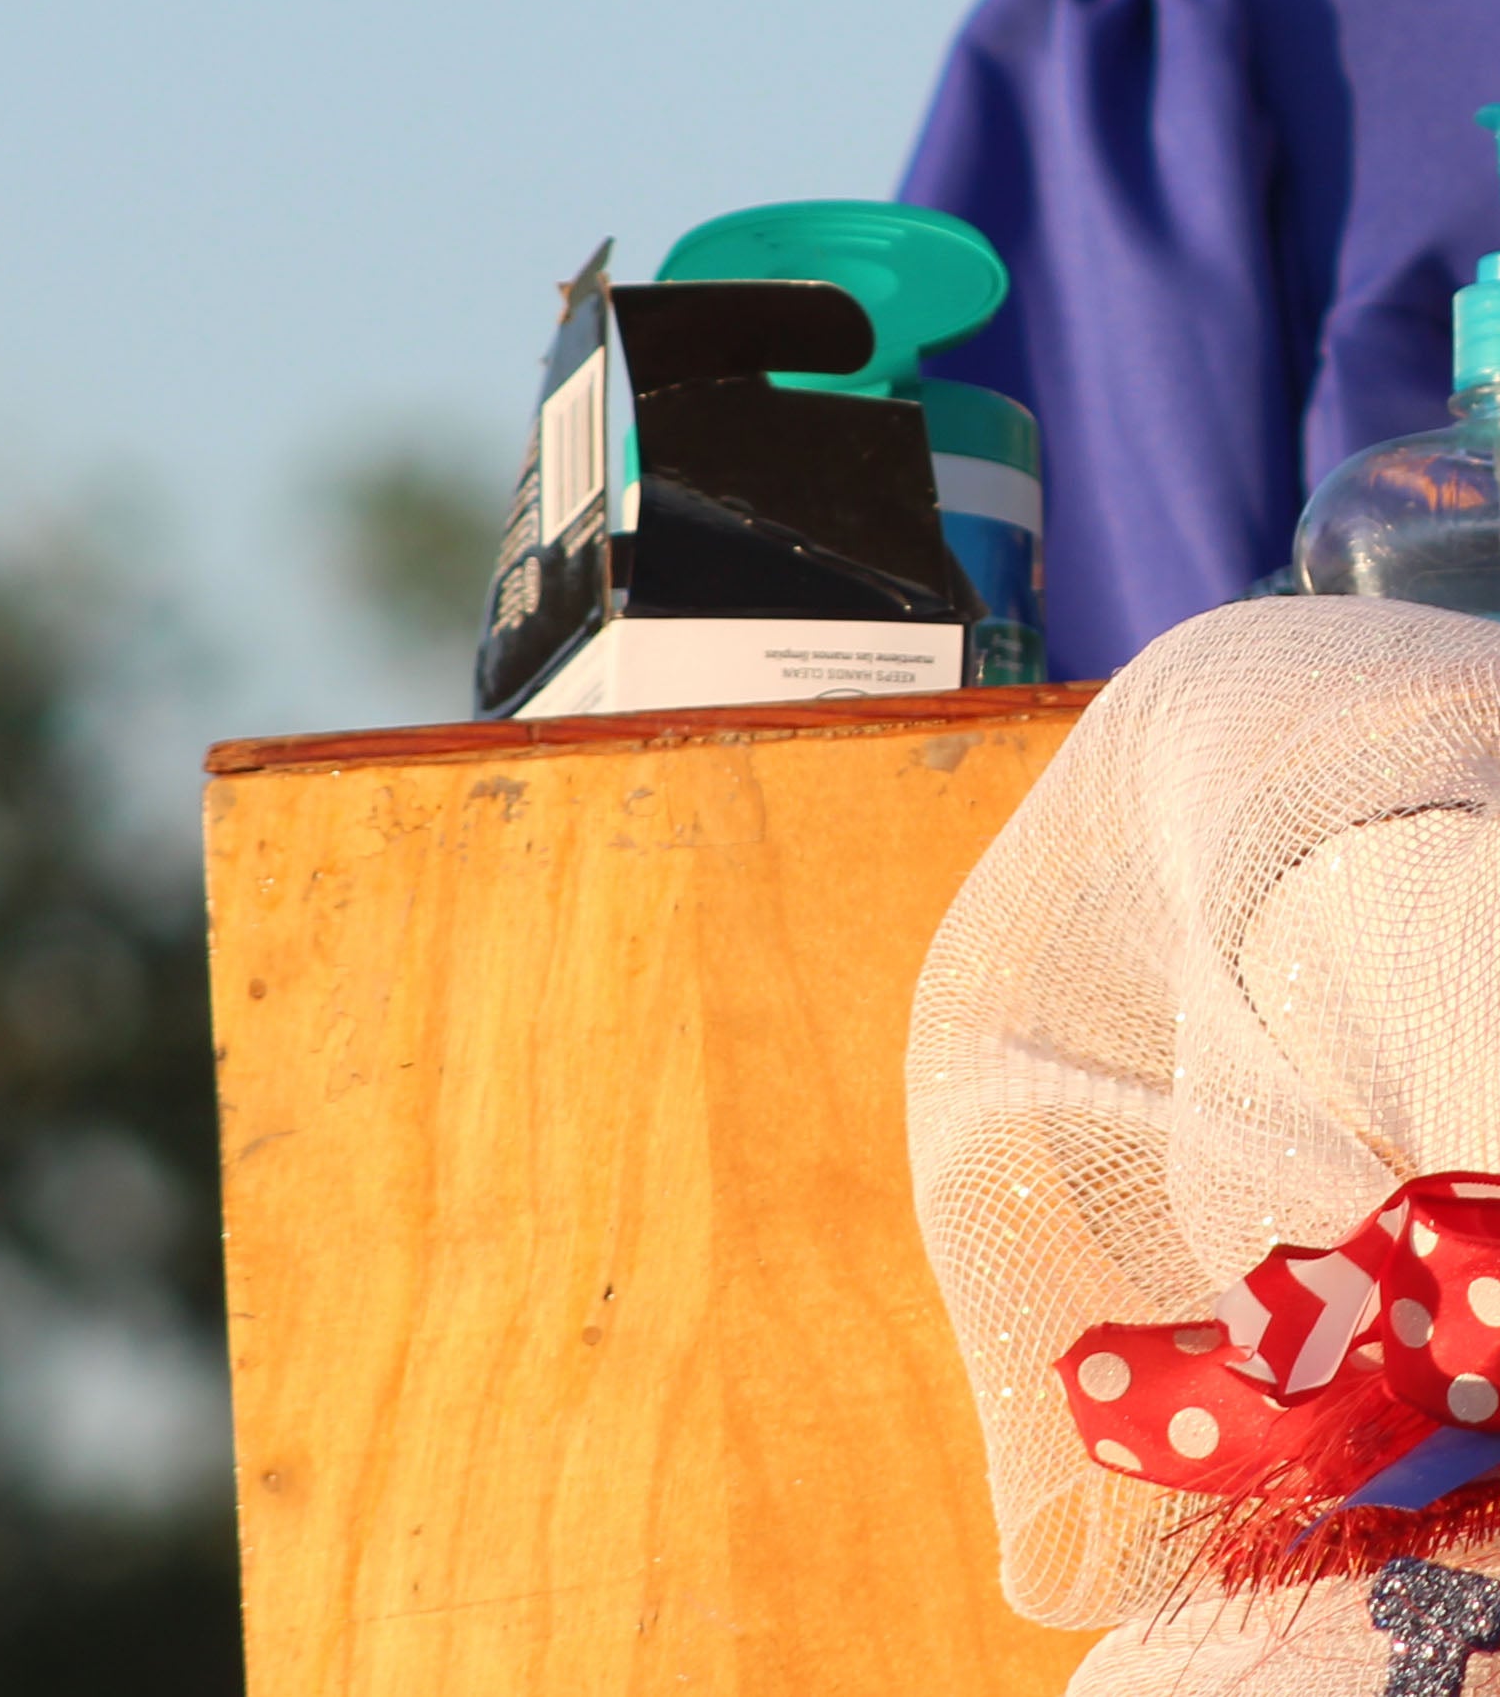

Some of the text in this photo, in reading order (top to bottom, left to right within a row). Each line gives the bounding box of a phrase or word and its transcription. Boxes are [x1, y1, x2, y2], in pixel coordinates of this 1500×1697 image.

[782, 667, 916, 682] KEEPS HANDS CLEAN
